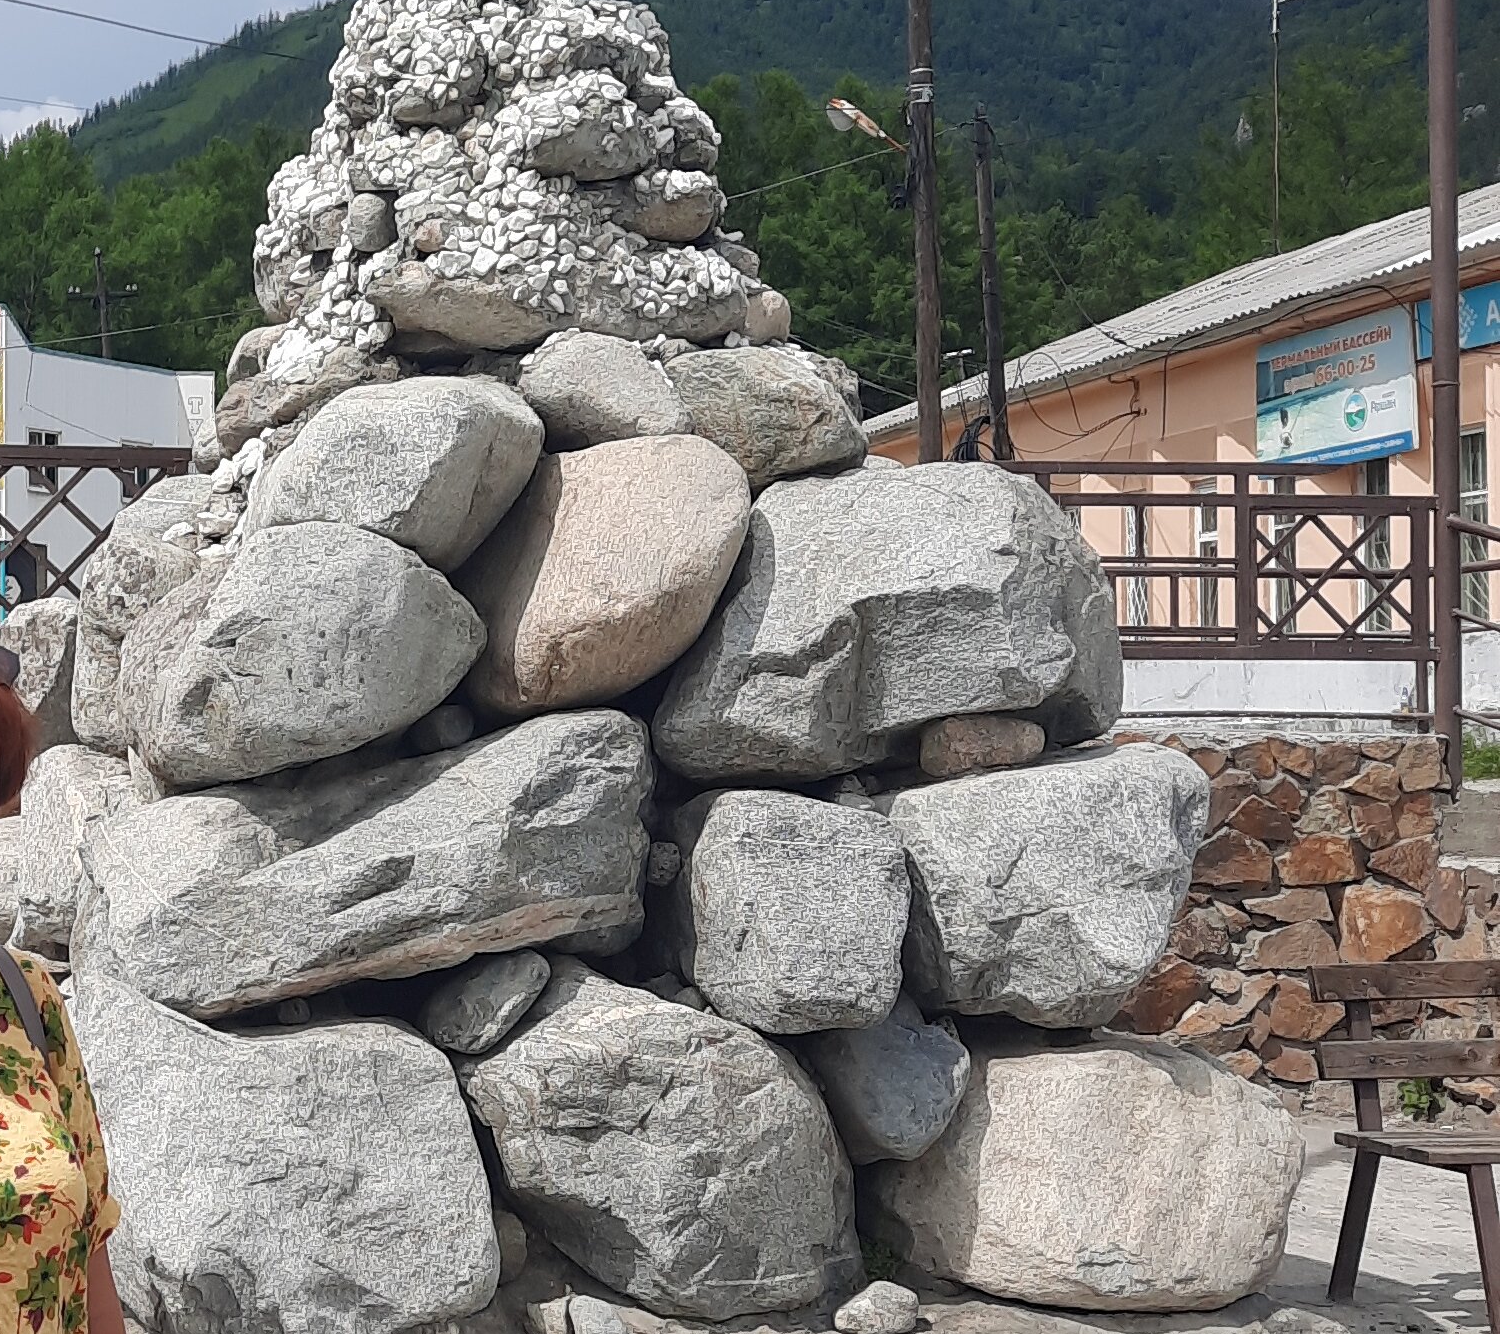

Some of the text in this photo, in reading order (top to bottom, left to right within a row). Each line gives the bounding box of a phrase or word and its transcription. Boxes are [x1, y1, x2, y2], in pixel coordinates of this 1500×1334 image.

[1270, 324, 1392, 371] ТЕРМАЛЬНЫЙ БАССЕЙН
[1315, 353, 1376, 384] 66-00-25
